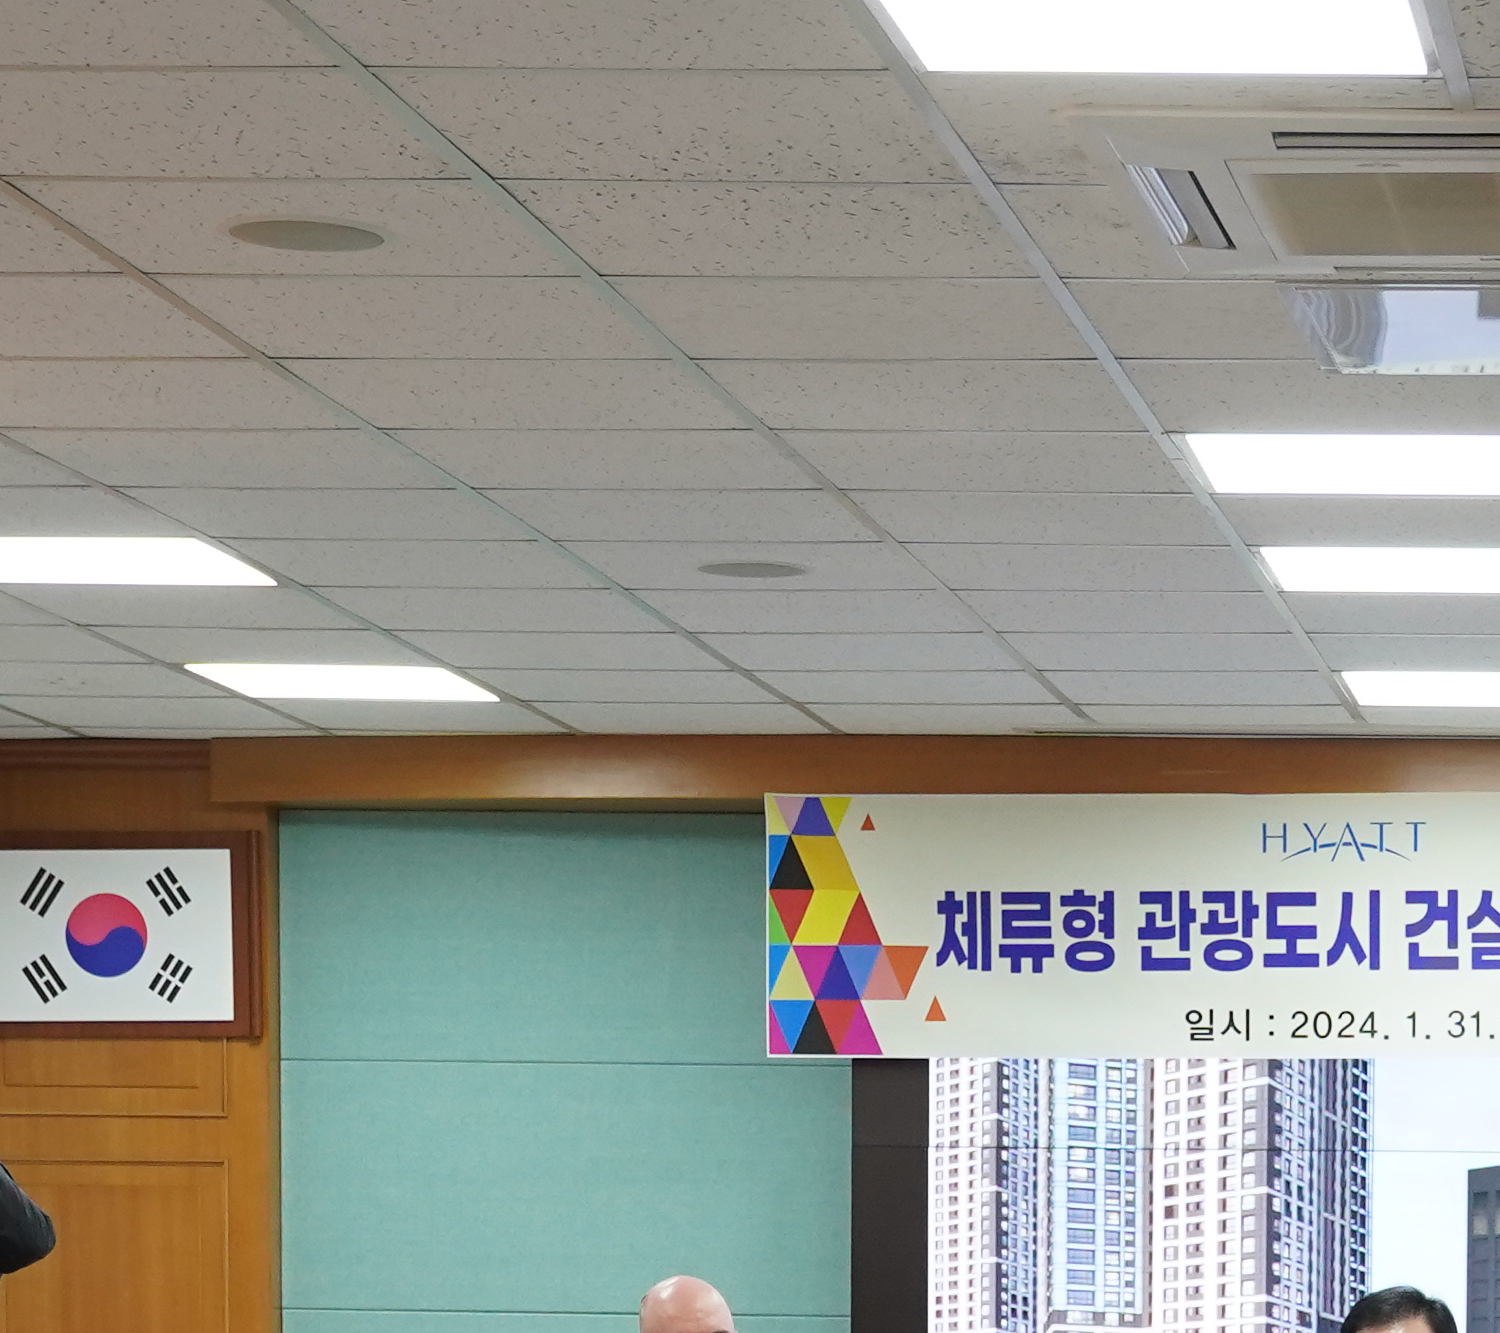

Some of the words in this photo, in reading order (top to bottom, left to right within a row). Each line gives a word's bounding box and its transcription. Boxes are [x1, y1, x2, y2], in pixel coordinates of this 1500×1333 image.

[1261, 821, 1427, 862] HYATT
[935, 888, 1116, 974] 체류형
[1137, 888, 1381, 972] 관광도시
[1184, 1009, 1251, 1042] 일시
[1290, 1010, 1390, 1041] 2024.
[1406, 1011, 1431, 1041] 1.
